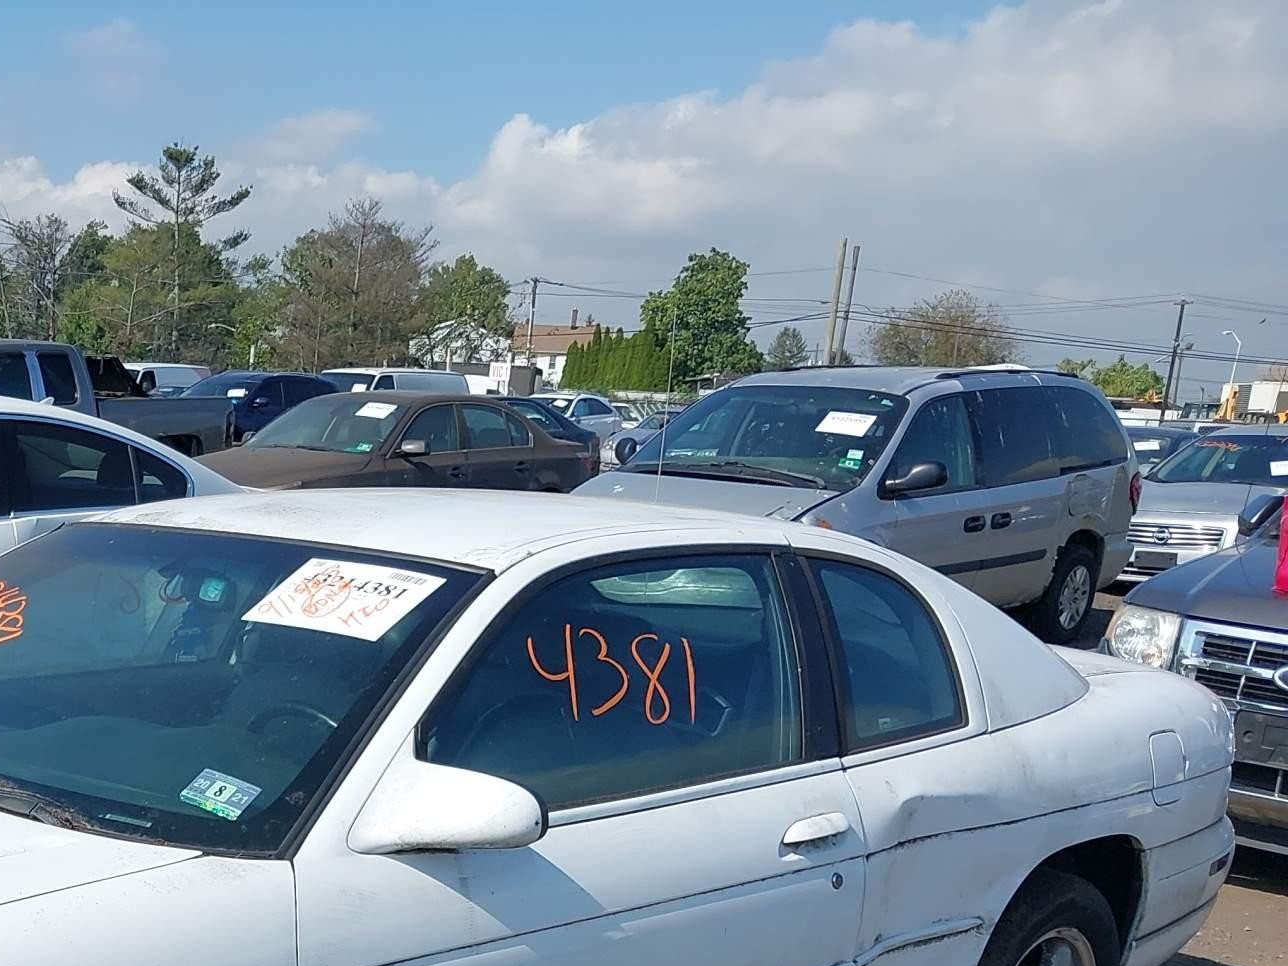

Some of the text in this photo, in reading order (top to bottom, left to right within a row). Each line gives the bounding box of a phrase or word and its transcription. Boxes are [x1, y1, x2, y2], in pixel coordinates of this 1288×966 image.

[526, 623, 696, 726] 4381
[193, 778, 249, 804] 20 8 21
